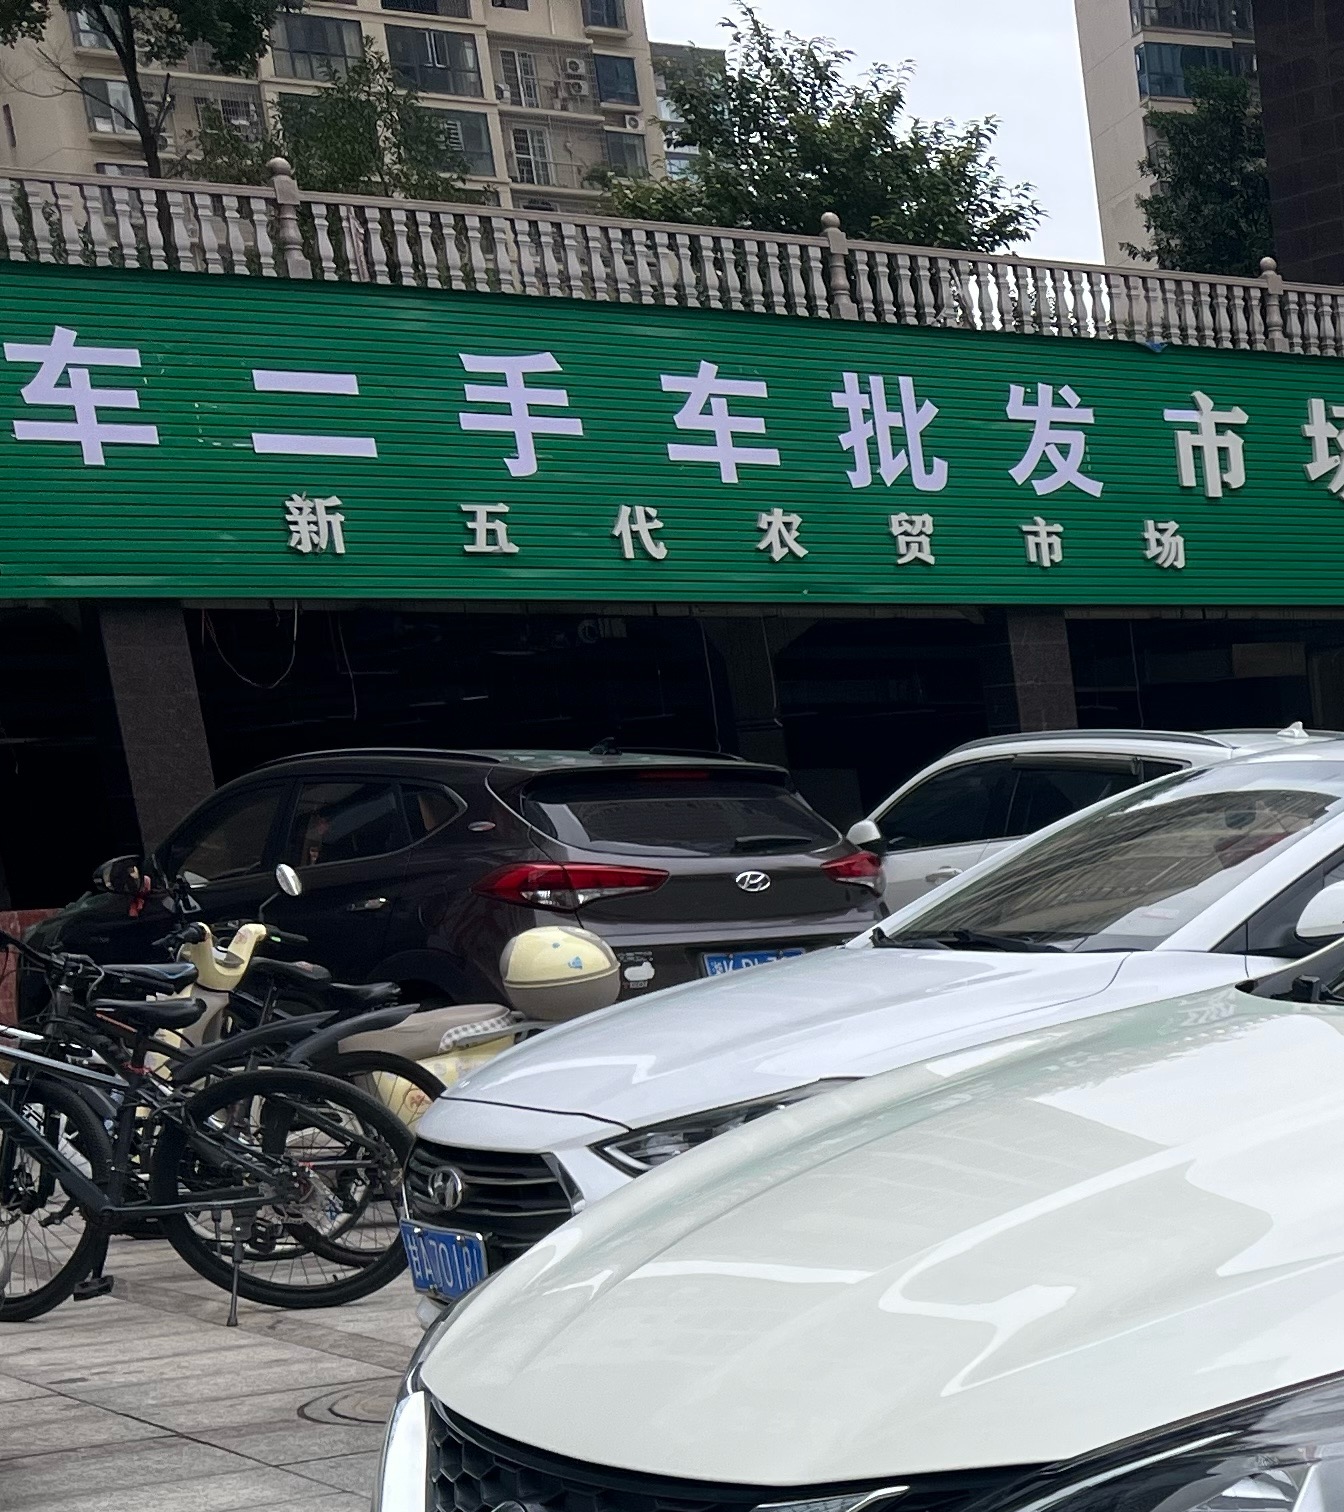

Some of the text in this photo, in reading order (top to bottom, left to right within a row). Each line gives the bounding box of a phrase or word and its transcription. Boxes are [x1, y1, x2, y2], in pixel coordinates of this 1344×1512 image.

[286, 491, 1188, 572] 新五代农贸市场
